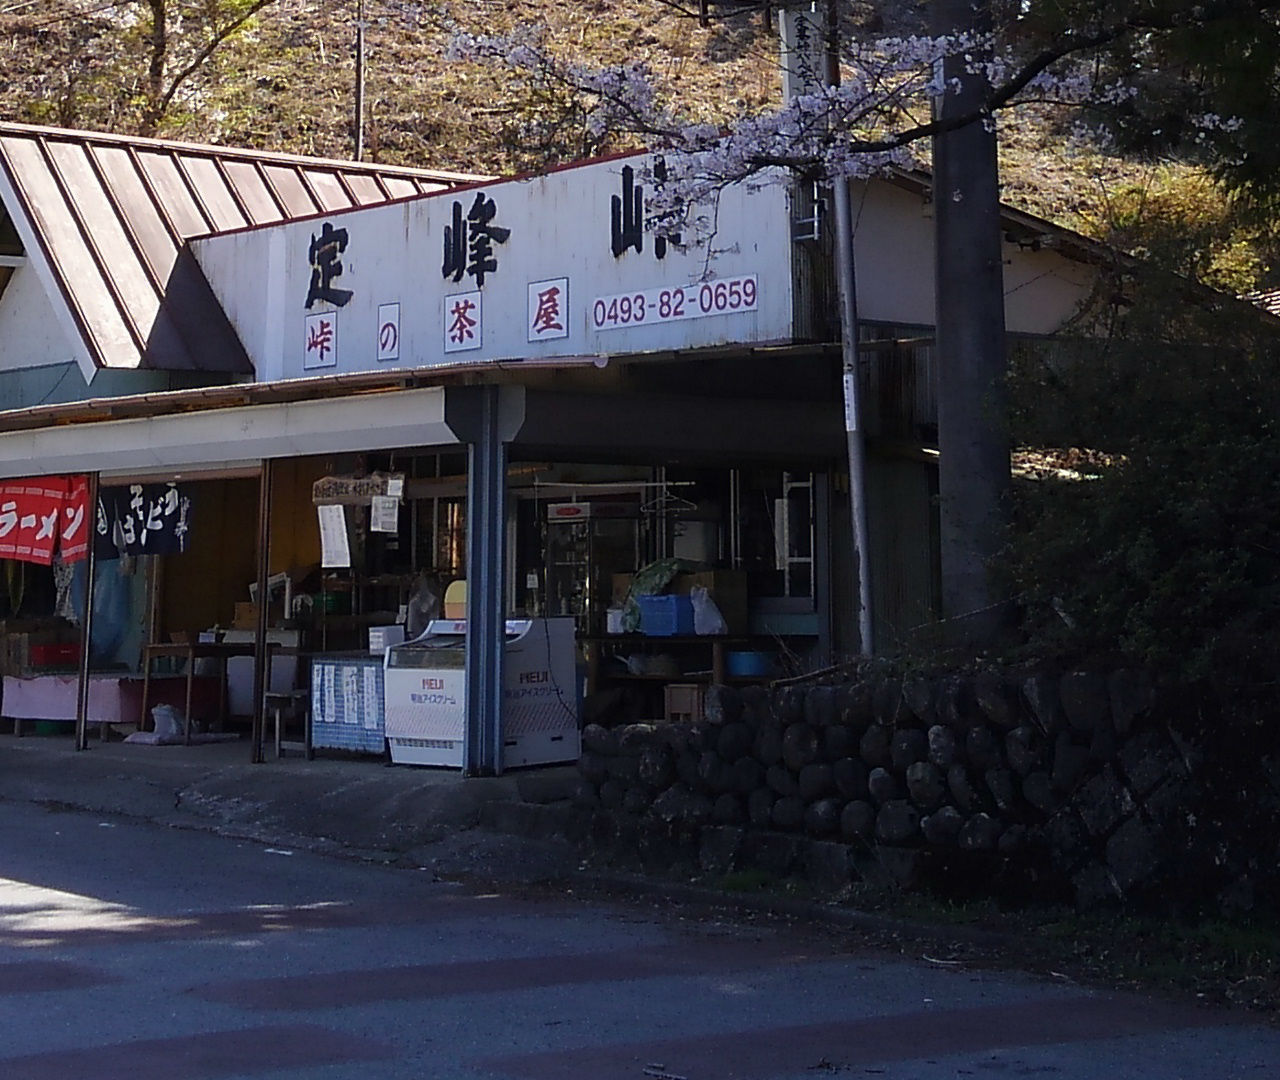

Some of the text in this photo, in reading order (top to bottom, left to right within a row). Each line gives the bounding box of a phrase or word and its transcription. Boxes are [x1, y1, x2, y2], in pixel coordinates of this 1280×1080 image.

[306, 285, 565, 362] 峠の茶屋
[593, 278, 757, 328] 0493-82-0659
